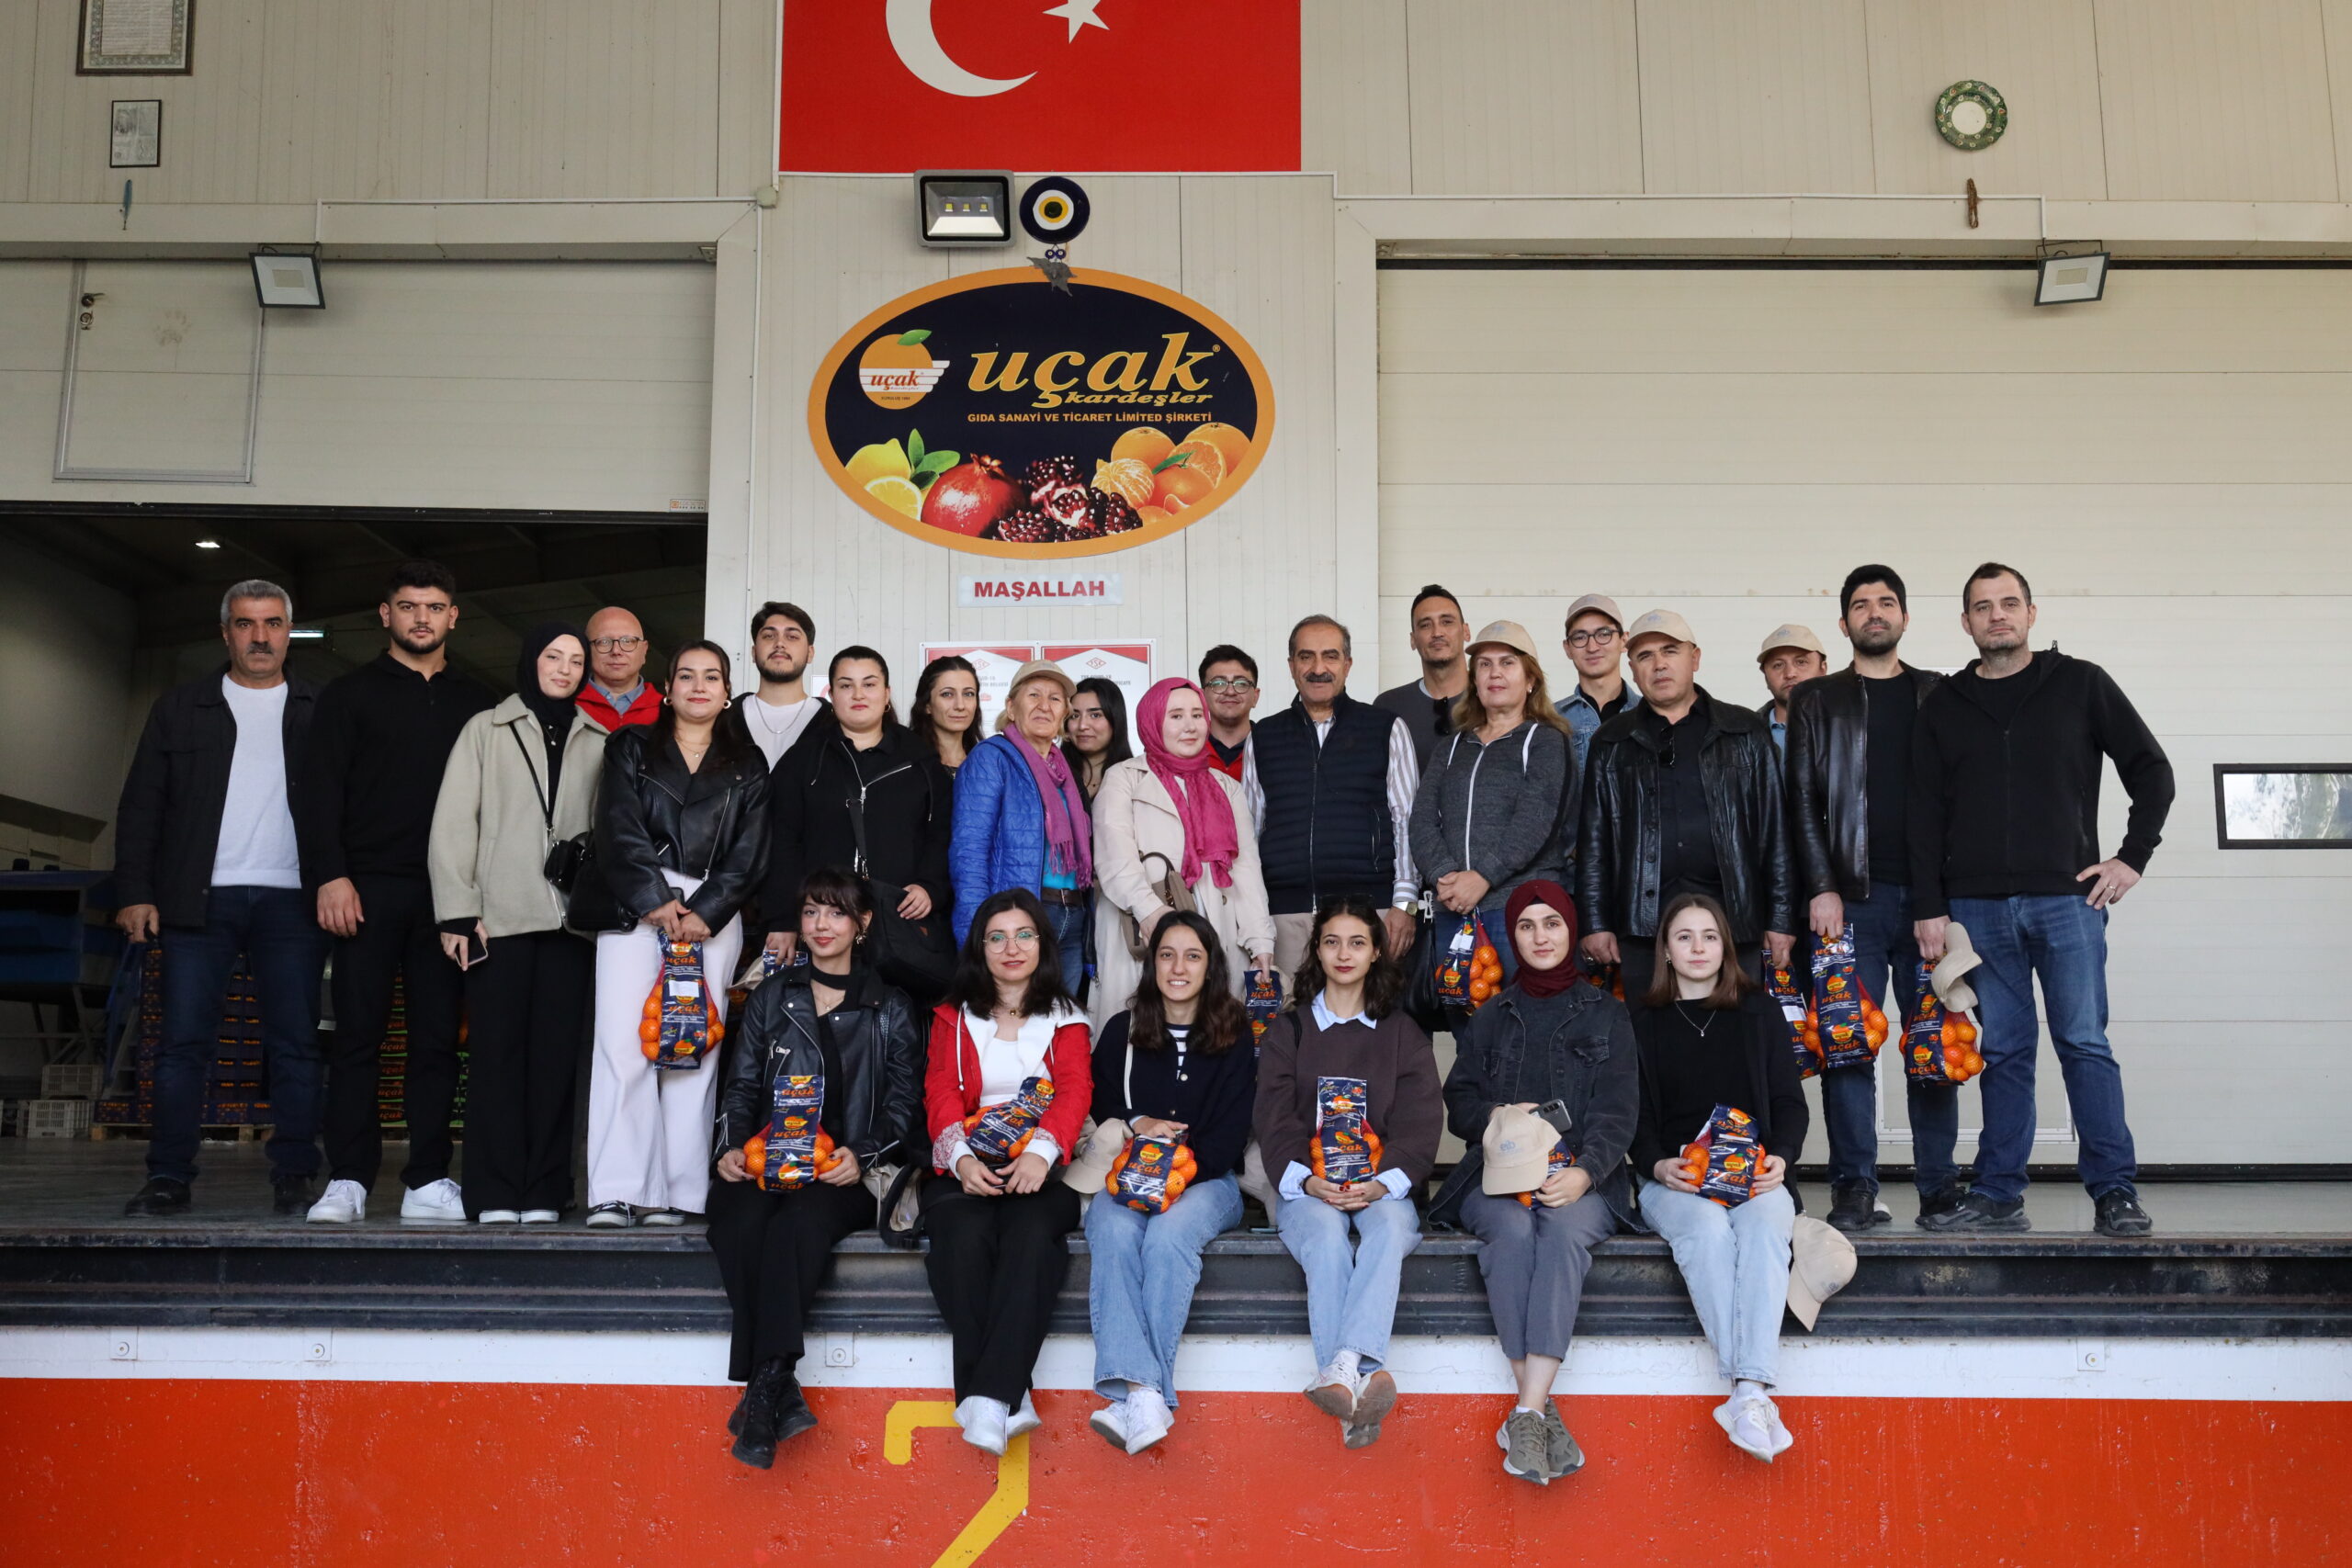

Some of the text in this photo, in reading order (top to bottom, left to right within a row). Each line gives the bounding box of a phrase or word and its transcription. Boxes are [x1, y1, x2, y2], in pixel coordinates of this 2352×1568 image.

[967, 332, 1215, 409] uçak
[870, 370, 920, 390] uçak
[1064, 391, 1214, 407] kardeşler
[967, 411, 1212, 424] GIDA SANAYİ VE TİCARET LİMİTED ŞİRKETİ
[974, 581, 1104, 602] MAŞALLAH
[1821, 991, 1852, 1004] uçak
[1828, 1039, 1861, 1052] uçak
[775, 1129, 808, 1139] uçak
[1127, 1161, 1162, 1175] uçak
